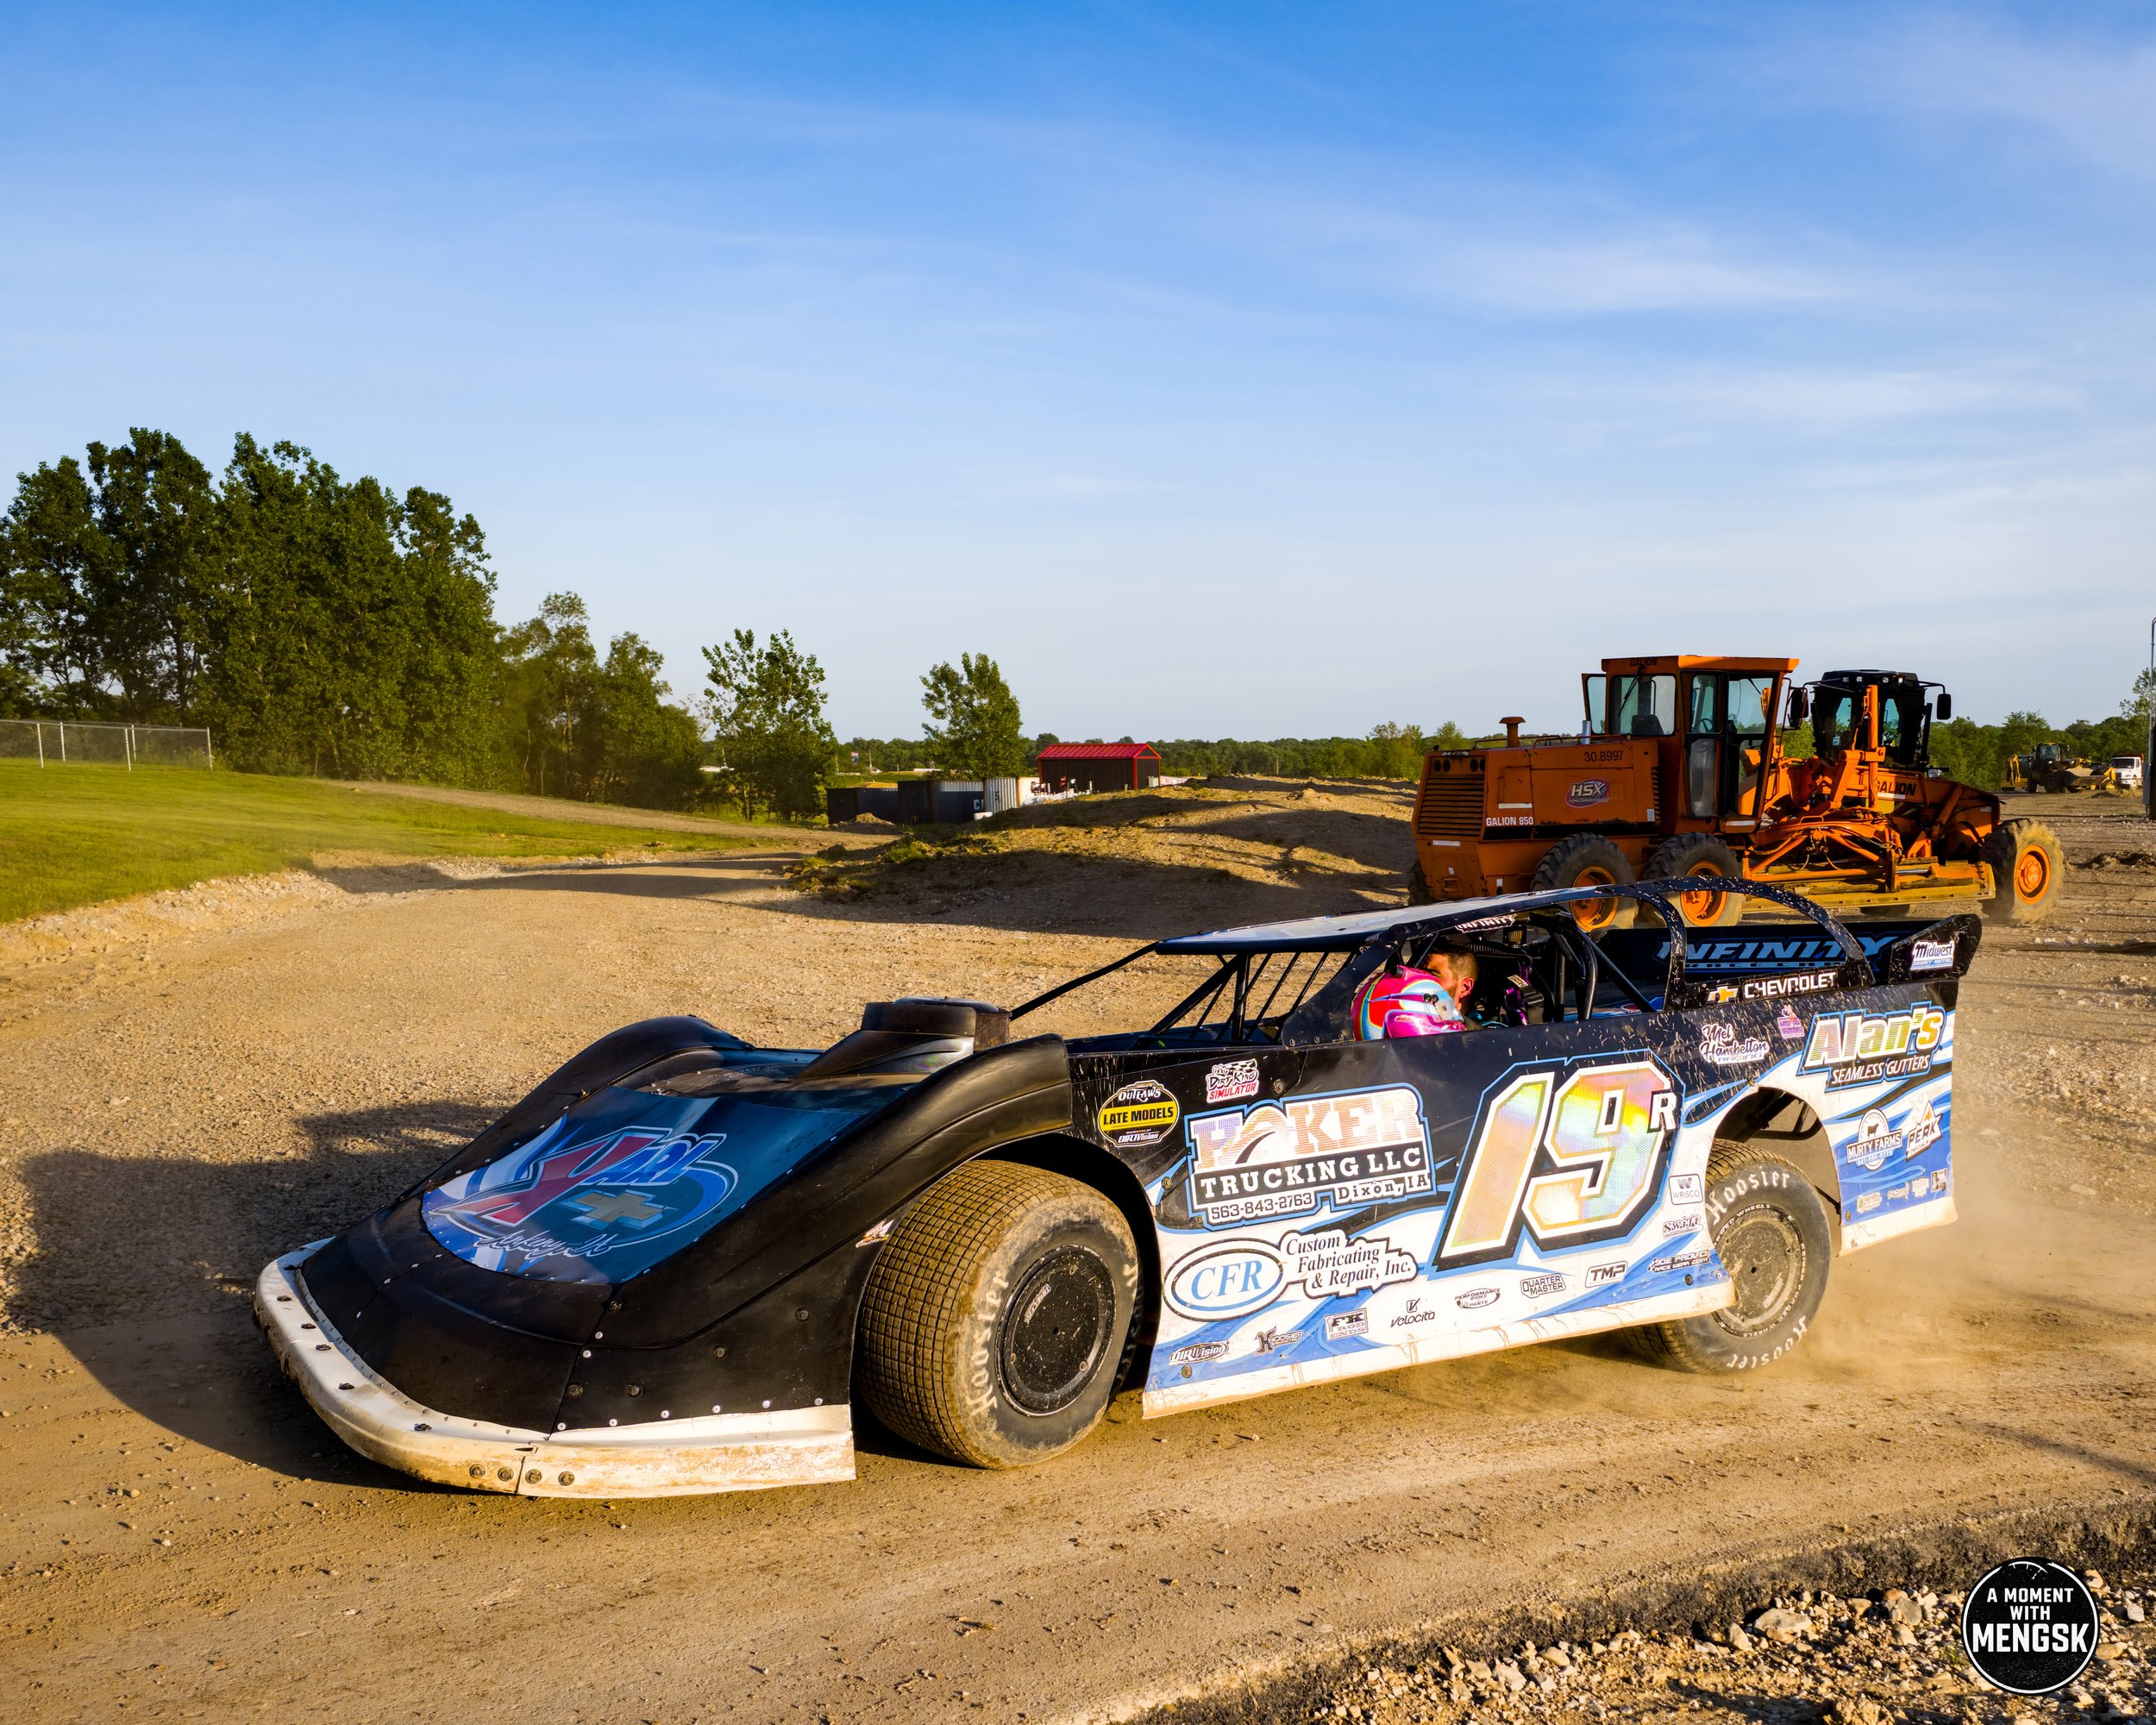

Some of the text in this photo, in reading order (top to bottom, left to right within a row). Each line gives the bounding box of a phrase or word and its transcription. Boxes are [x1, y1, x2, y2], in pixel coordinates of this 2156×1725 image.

[1584, 750, 1623, 762] 30.8997
[1571, 782, 1605, 797] HSX
[1486, 816, 1534, 826] GALION 850
[1457, 913, 1517, 929] INFINITY
[1912, 942, 1953, 958] Midwest
[1744, 971, 1837, 999] CHEVROLET
[1702, 1024, 1732, 1041] Mel
[1805, 1007, 1944, 1067] Alan's
[1831, 1055, 1930, 1084] SEAMLESS GUTTERS
[1209, 1083, 1257, 1100] SIMULATOR
[1103, 1107, 1174, 1125] LATE MODELS
[1908, 1120, 1937, 1149] PEAK
[1847, 1139, 1874, 1160] MURTY
[1875, 1132, 1902, 1151] FARMS
[1200, 1147, 1421, 1198] TRUCKING LLC
[1338, 1174, 1428, 1200] Dixon, IA
[1672, 1189, 1701, 1199] WRISCO
[1211, 1193, 1313, 1219] 563-843-2763
[1705, 1170, 1790, 1226] Hoosier
[1736, 1204, 1771, 1217] WHEELS
[1286, 1236, 1340, 1255] Custom
[1298, 1246, 1380, 1273] Fabricating
[1675, 1251, 1708, 1263] PROVO
[1191, 1260, 1263, 1301] CFR
[1312, 1259, 1412, 1289] & Repair, Inc.
[1590, 1264, 1626, 1282] TMP
[1522, 1275, 1561, 1292] QUARTER
[1530, 1282, 1564, 1295] MASTER
[1455, 1288, 1501, 1301] PERFORMANCE
[965, 1271, 1010, 1416] Hoosier
